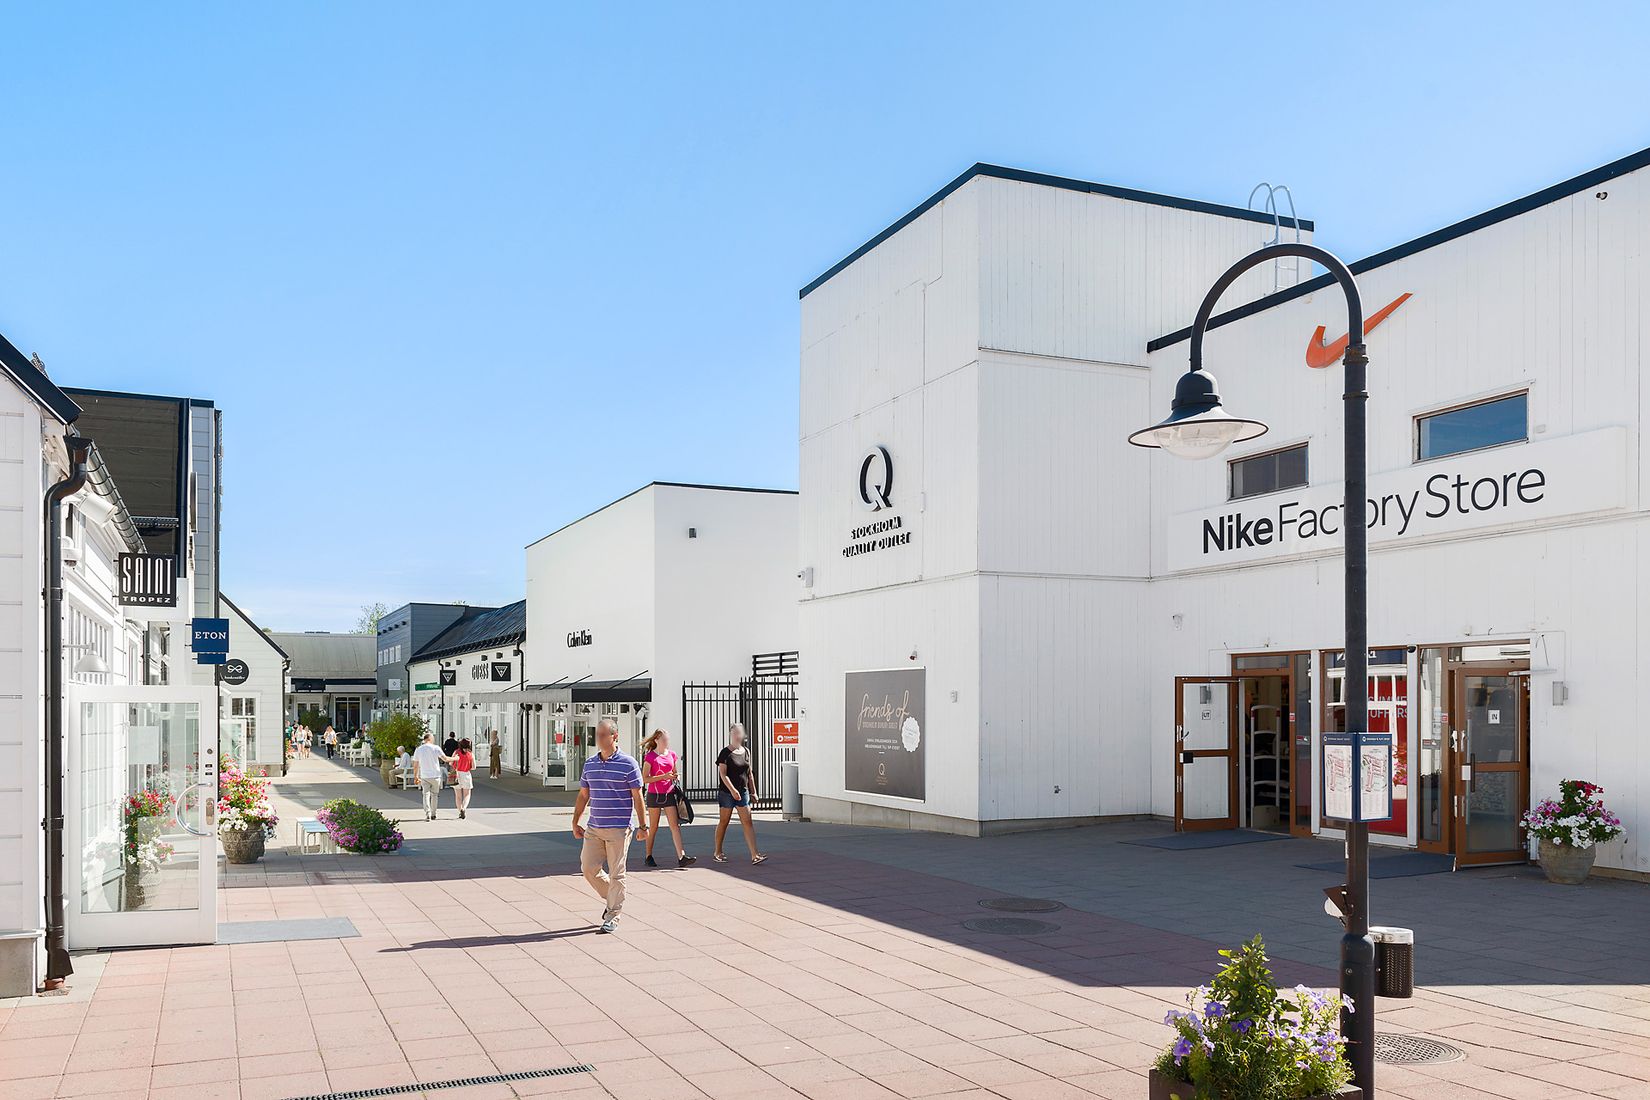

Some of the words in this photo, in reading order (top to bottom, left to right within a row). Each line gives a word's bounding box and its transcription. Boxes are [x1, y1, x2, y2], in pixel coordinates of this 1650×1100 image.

[1203, 513, 1273, 554] Nike
[1425, 467, 1546, 519] Store
[851, 516, 902, 540] STOCKHOLM
[842, 540, 877, 557] QUALITY
[879, 532, 911, 550] OUTLET
[122, 556, 173, 595] SAINT
[122, 596, 171, 604] TROPEZ
[194, 632, 227, 640] ETON
[857, 693, 894, 731] friends
[895, 690, 909, 731] of
